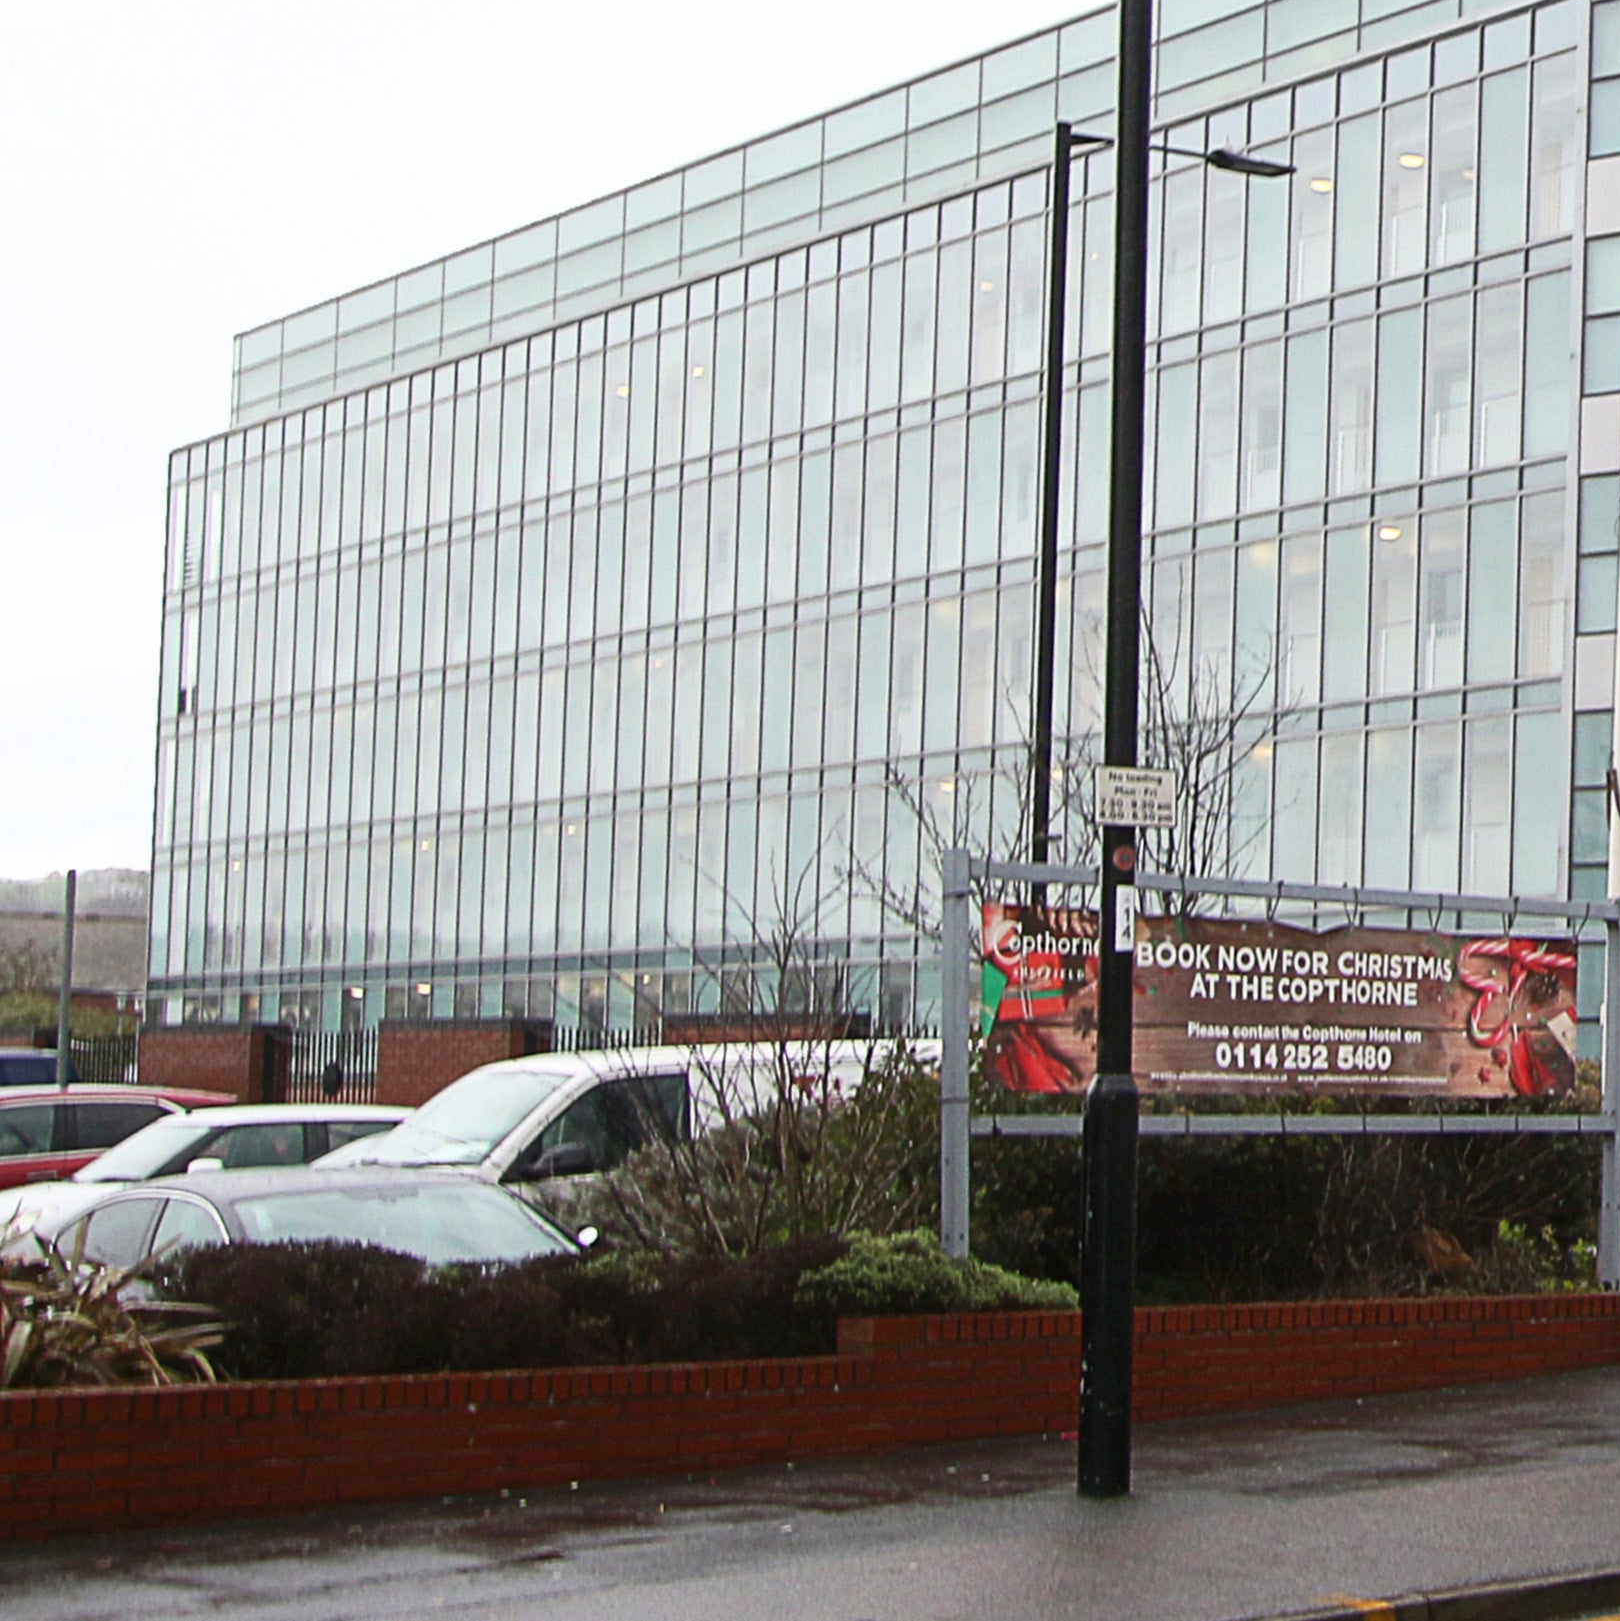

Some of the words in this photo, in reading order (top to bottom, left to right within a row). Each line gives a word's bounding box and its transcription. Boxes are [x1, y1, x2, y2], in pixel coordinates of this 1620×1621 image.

[1109, 771, 1123, 782] No
[1114, 785, 1136, 795] Mon
[1136, 942, 1212, 970] BOOK
[1217, 946, 1278, 974] NOW
[1282, 950, 1329, 976] FOR
[1337, 951, 1453, 983] CHRISTMAS
[1190, 973, 1219, 999] AT
[1226, 975, 1274, 1002] THE
[1277, 978, 1418, 1007] COPTHORNE
[1187, 1021, 1230, 1038] Please
[1232, 1023, 1280, 1041] contact
[1281, 1025, 1300, 1041] the
[1302, 1025, 1367, 1044] Copthorne
[1369, 1027, 1402, 1042] Hotel
[1403, 1030, 1423, 1044] on
[1215, 1042, 1278, 1070] 0114
[1282, 1044, 1329, 1070] 252
[1337, 1045, 1392, 1072] 5480
